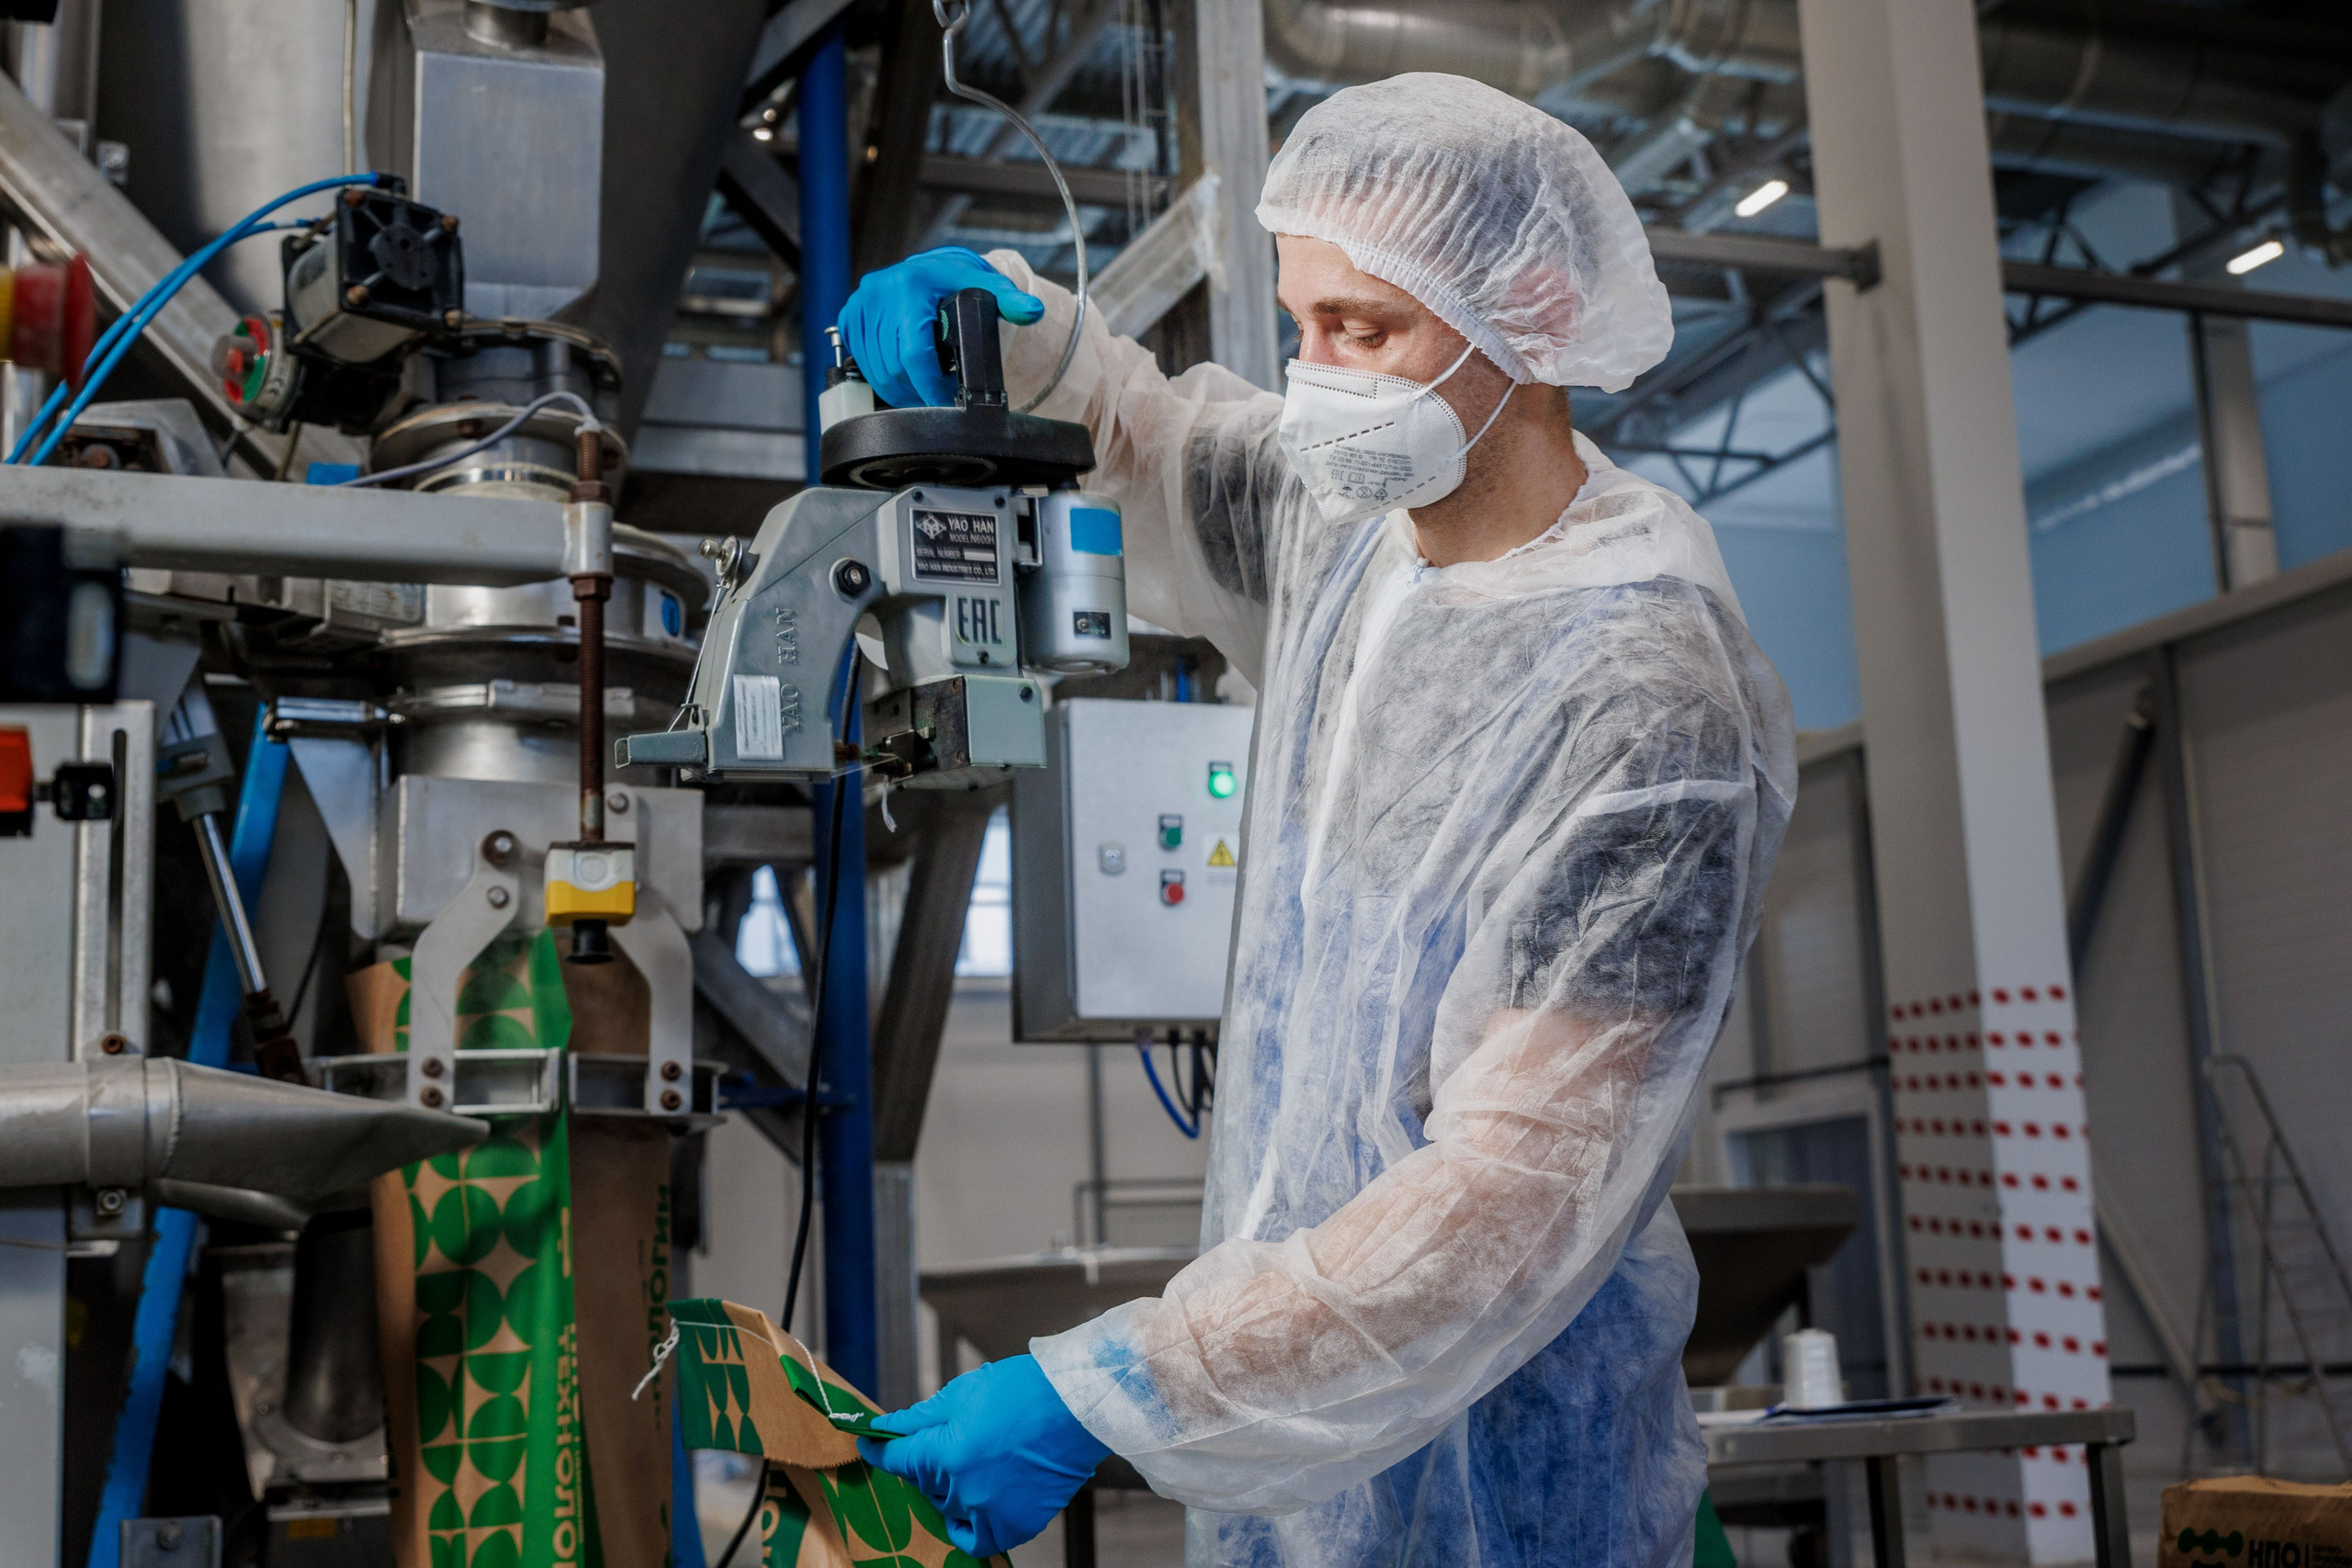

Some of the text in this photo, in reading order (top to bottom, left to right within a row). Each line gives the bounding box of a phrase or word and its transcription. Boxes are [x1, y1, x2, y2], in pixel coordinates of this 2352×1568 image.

[948, 518, 994, 534] YAO HAN
[917, 547, 961, 559] SERIAL NUMBER
[942, 564, 973, 574] INDUSTRIES
[957, 597, 1002, 644] EAC
[775, 607, 799, 736] YAO HAN
